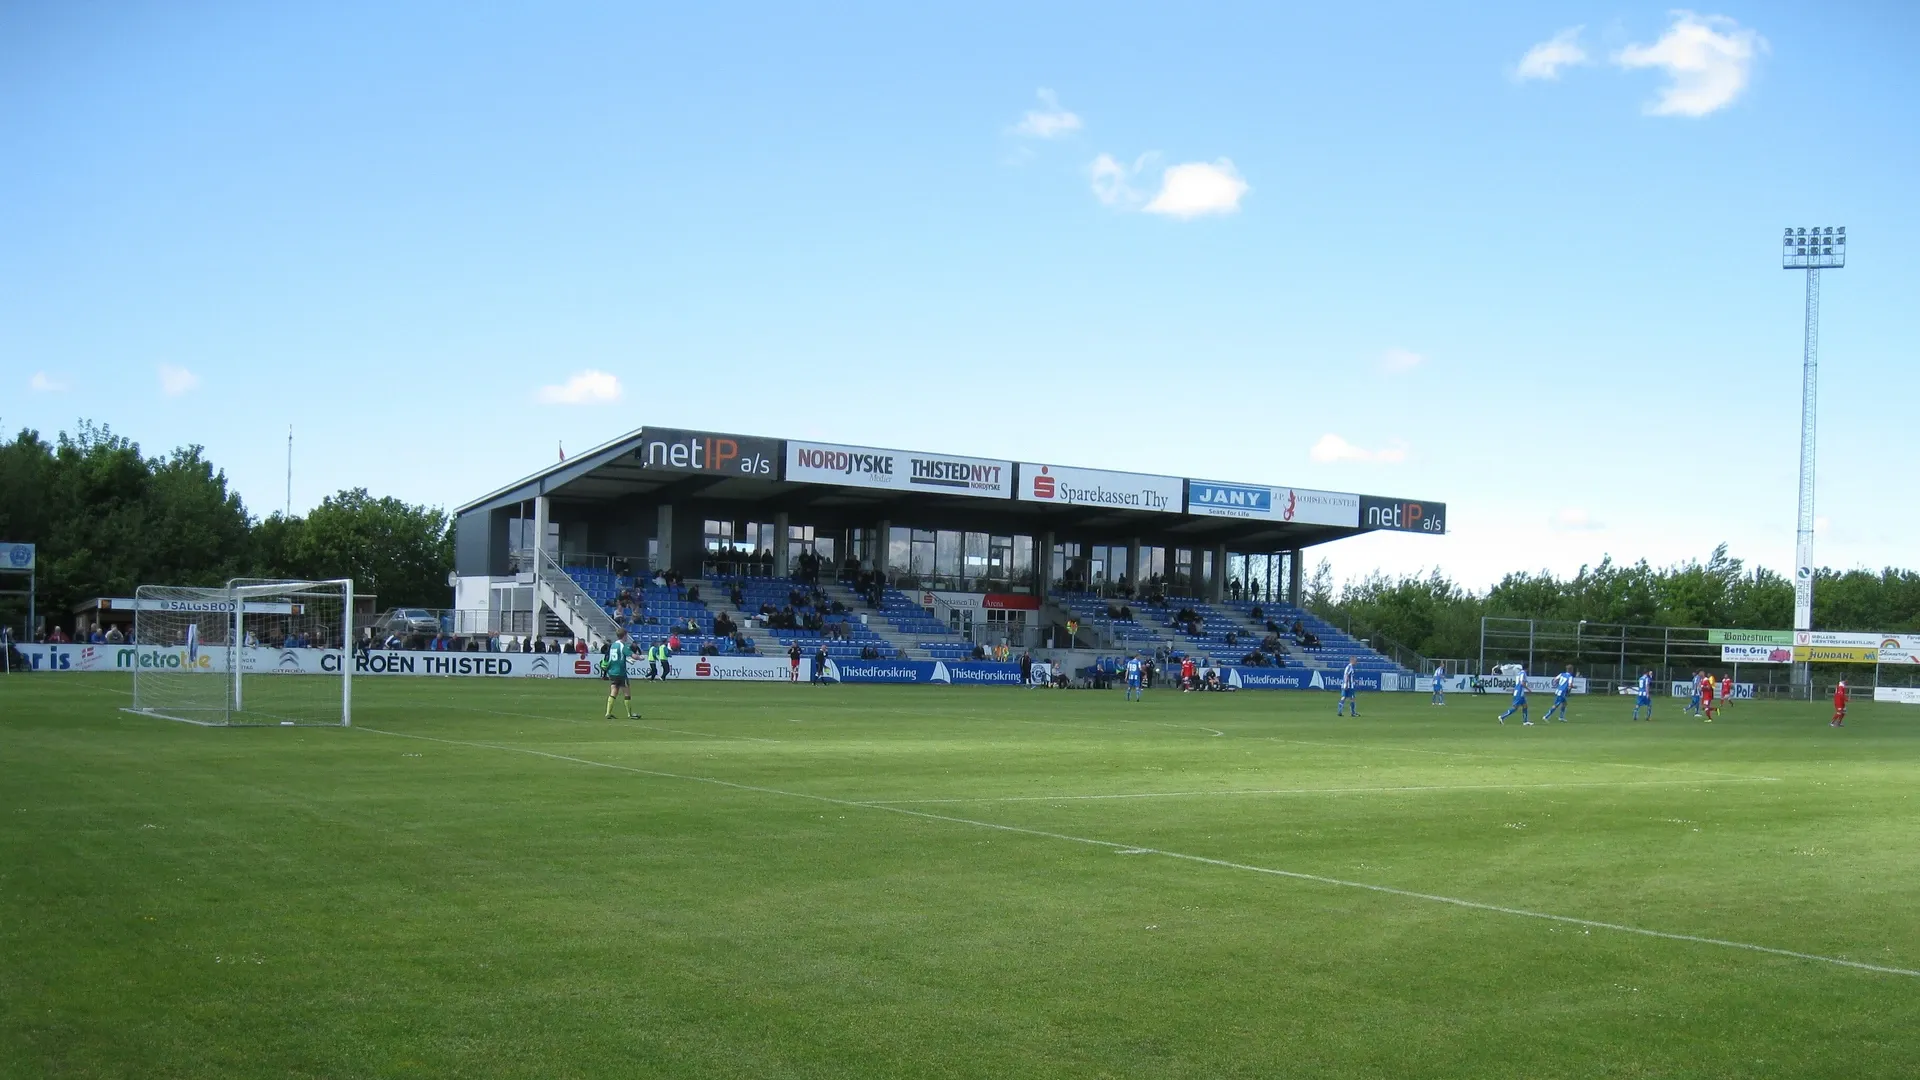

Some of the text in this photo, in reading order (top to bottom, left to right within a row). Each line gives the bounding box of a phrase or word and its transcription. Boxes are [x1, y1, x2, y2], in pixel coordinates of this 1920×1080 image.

[649, 438, 770, 474] netIP a/s
[798, 449, 893, 475] NORDJYSKE
[911, 459, 1001, 484] THISTEDNYT
[971, 482, 1001, 491] NORDJYSKE
[1060, 482, 1168, 511] Sparekassen Thy
[1200, 488, 1261, 506] JANY
[1208, 508, 1250, 518] Seats for Life
[1368, 503, 1442, 531] netIP a/s
[986, 600, 1004, 608] Arena
[1724, 646, 1768, 655] Bette Gris
[423, 656, 512, 675] THISTED
[713, 665, 774, 679] Sparekassen
[841, 666, 917, 681] ThistedForsikring
[951, 668, 1022, 683] ThistedForsikring
[1243, 674, 1300, 688] ThistedForsikring
